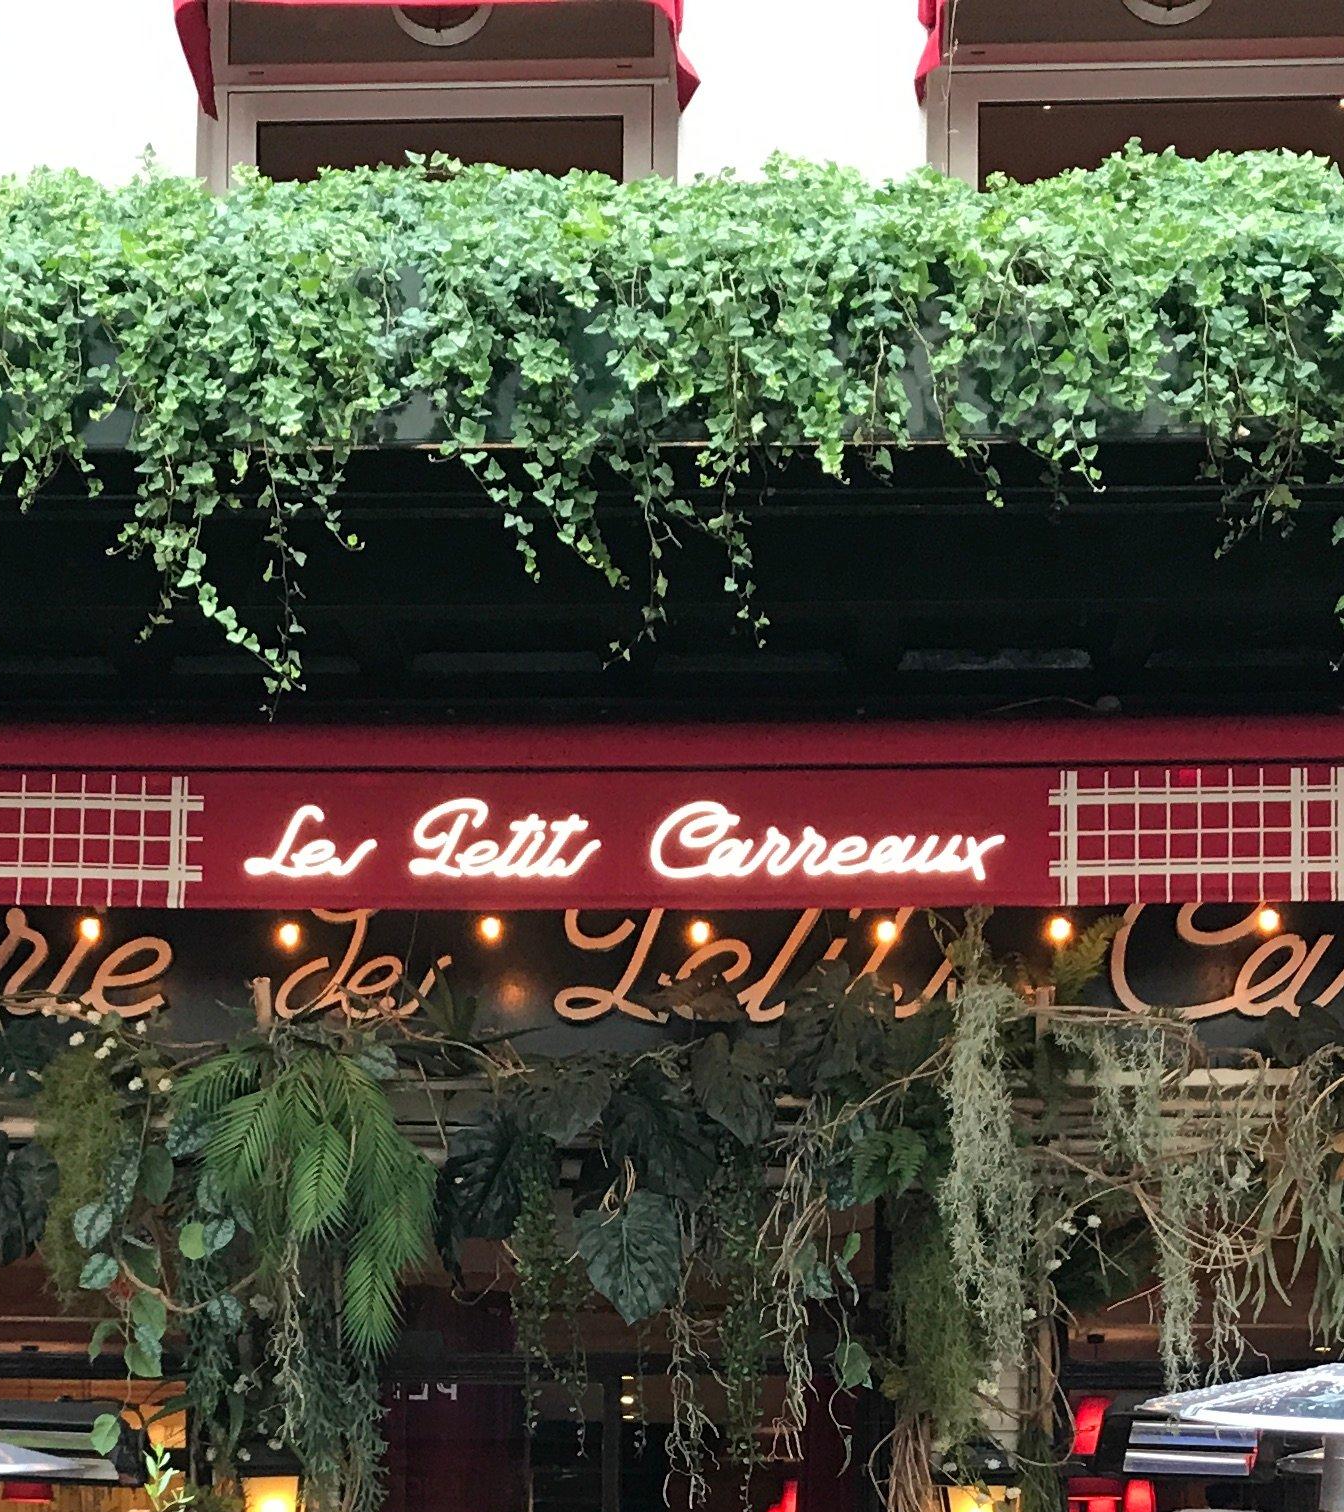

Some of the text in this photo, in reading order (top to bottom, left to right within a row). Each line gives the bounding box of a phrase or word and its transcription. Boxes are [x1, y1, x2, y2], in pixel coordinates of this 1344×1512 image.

[244, 797, 1006, 882] Les Petits Carreaux
